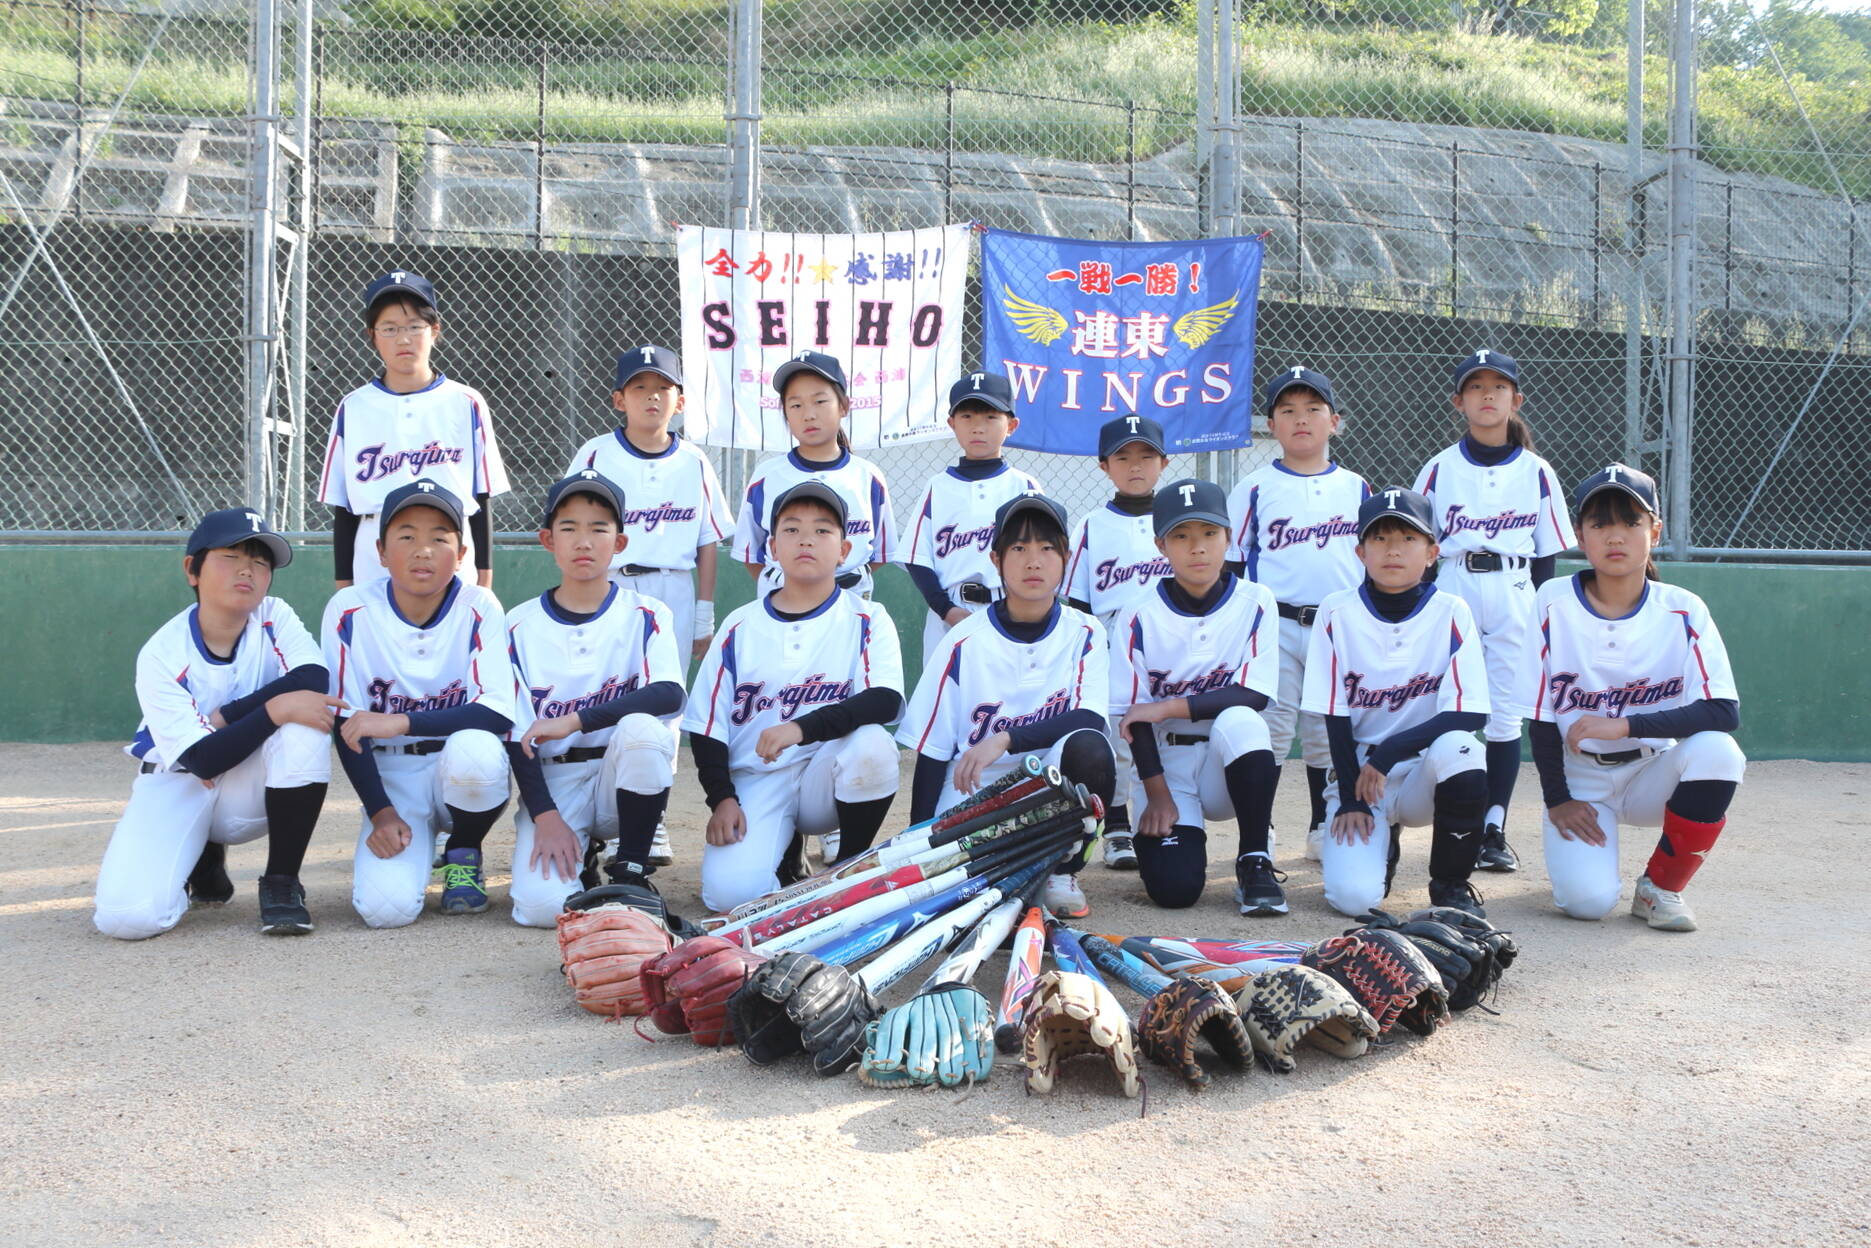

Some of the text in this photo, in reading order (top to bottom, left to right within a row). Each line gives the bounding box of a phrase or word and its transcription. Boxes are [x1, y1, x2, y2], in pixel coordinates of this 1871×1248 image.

[391, 271, 406, 284] T
[1047, 260, 1201, 296] 一戦一勝!
[702, 299, 944, 350] SEIHO
[1070, 310, 1170, 361] 連東
[640, 346, 655, 364] T
[1476, 349, 1490, 364] T
[971, 373, 985, 390] T
[1290, 366, 1305, 379] T
[1003, 360, 1233, 412] WINGS
[1126, 416, 1140, 434] T
[581, 469, 598, 480] T
[1604, 465, 1623, 483] T
[417, 482, 436, 493] T
[1179, 484, 1196, 507] T
[1384, 489, 1401, 510] T
[245, 512, 262, 533] T
[1441, 504, 1538, 541] Tsurajima
[1549, 672, 1685, 719] Tsurajima
